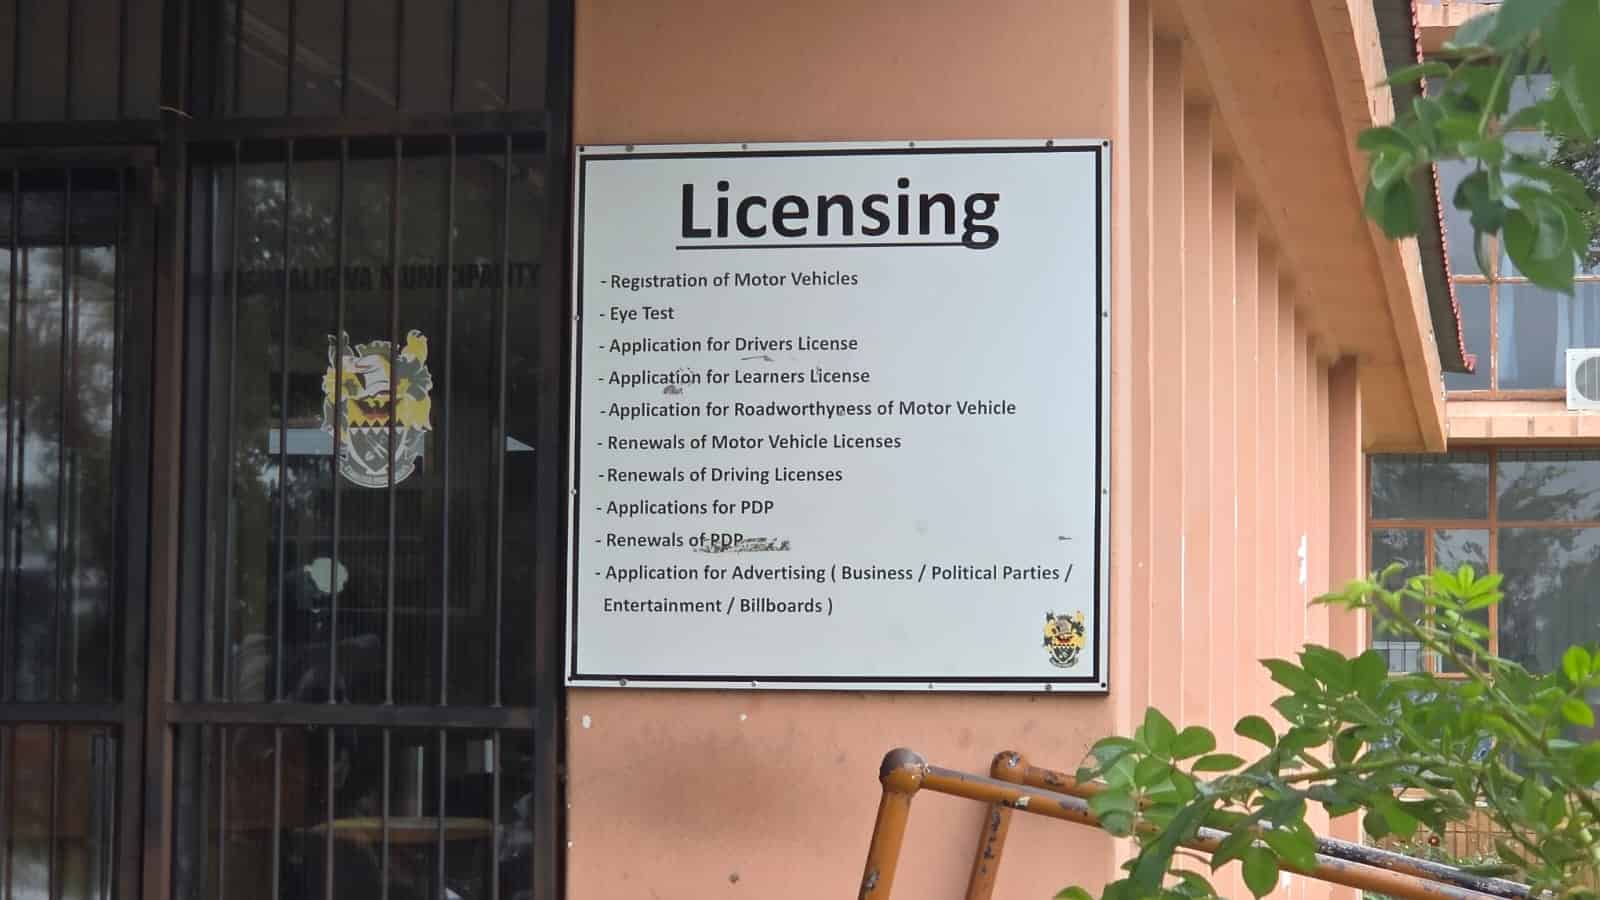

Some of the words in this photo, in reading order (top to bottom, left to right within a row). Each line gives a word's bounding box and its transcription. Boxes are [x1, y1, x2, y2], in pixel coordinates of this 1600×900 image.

[681, 178, 1000, 250] Licensing
[611, 273, 707, 291] Registration
[713, 272, 731, 287] of
[735, 272, 787, 287] Motor
[791, 271, 858, 286] Vehicles
[610, 306, 638, 323] Eye
[642, 306, 675, 321] Test
[609, 337, 702, 356] Application
[707, 337, 731, 352] for
[735, 336, 793, 352] Drivers
[798, 336, 858, 351] License
[609, 369, 701, 387] Application
[707, 369, 730, 384] for
[735, 369, 805, 384] Learners
[810, 368, 870, 383] License
[608, 402, 701, 420] Application
[706, 401, 730, 417] for
[735, 401, 872, 419] Roadworthyness
[877, 400, 894, 416] of
[899, 401, 952, 416] Motor
[956, 400, 1016, 415] Vehicle
[608, 434, 685, 450] Renewals
[690, 434, 708, 449] of
[712, 435, 765, 449] Motor
[769, 434, 828, 449] Vehicle
[833, 434, 901, 449] Licenses
[607, 466, 685, 482] Renewals
[689, 466, 707, 482] of
[711, 467, 770, 485] Driving
[775, 466, 843, 482] Licenses
[606, 499, 708, 517] Applications
[712, 499, 737, 515] for
[741, 500, 774, 515] PDP
[606, 531, 684, 547] Renewals
[688, 532, 706, 548] of
[710, 533, 744, 548] PDP
[605, 564, 699, 583] Application
[703, 564, 728, 580] for
[731, 564, 826, 584] Advertising
[841, 565, 913, 580] Business
[932, 565, 997, 580] Political
[1003, 565, 1060, 580] Parties
[604, 597, 722, 613] Entertainment
[740, 597, 823, 613] Billboards
